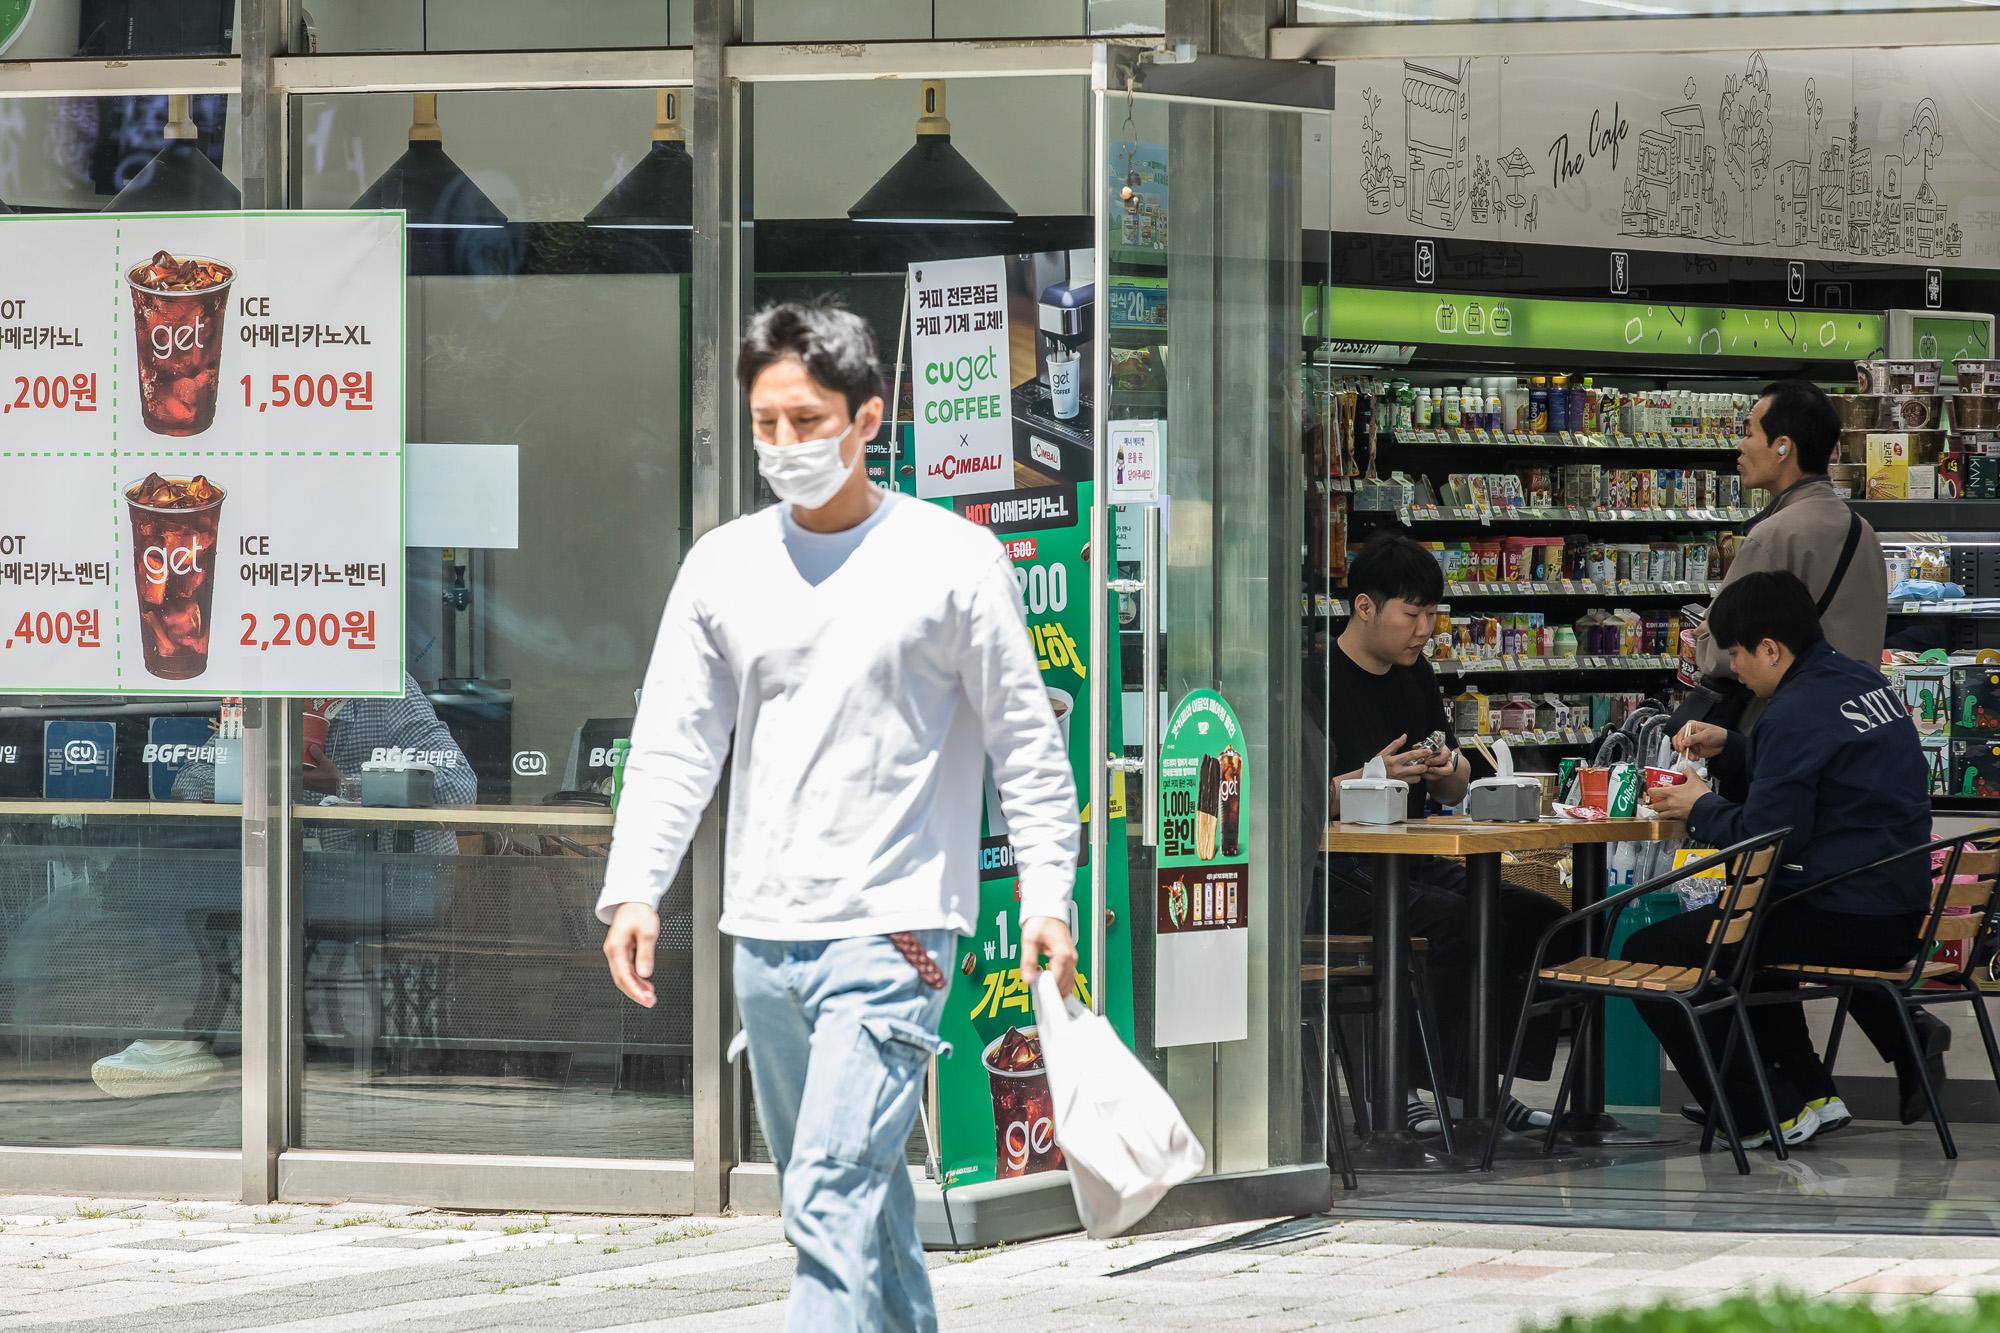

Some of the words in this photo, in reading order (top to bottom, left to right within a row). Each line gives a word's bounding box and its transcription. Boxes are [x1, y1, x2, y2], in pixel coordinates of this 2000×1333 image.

[4, 15, 11, 26] 5
[1549, 133, 1585, 189] The
[1588, 101, 1629, 172] Cafe
[240, 297, 271, 317] ICE
[918, 288, 943, 309] 커피
[946, 284, 998, 308] 전문점급
[240, 324, 372, 348] 아메리카노XL
[916, 317, 941, 337] 커피
[944, 313, 970, 334] 기계
[973, 310, 1003, 332] 교체!
[151, 315, 205, 360] get
[240, 371, 374, 413] 1,500원
[1052, 370, 1070, 388] get
[1052, 387, 1071, 395] COFFEE
[924, 394, 1002, 424] COFFEE
[1884, 441, 1893, 468] 보리차
[239, 536, 270, 556] ICE
[143, 535, 203, 585] get
[239, 561, 386, 587] 아메리카노벤티
[239, 609, 376, 651] 2,200원
[47, 748, 110, 777] 플틱
[1221, 779, 1239, 801] get
[1163, 818, 1196, 857] 할인
